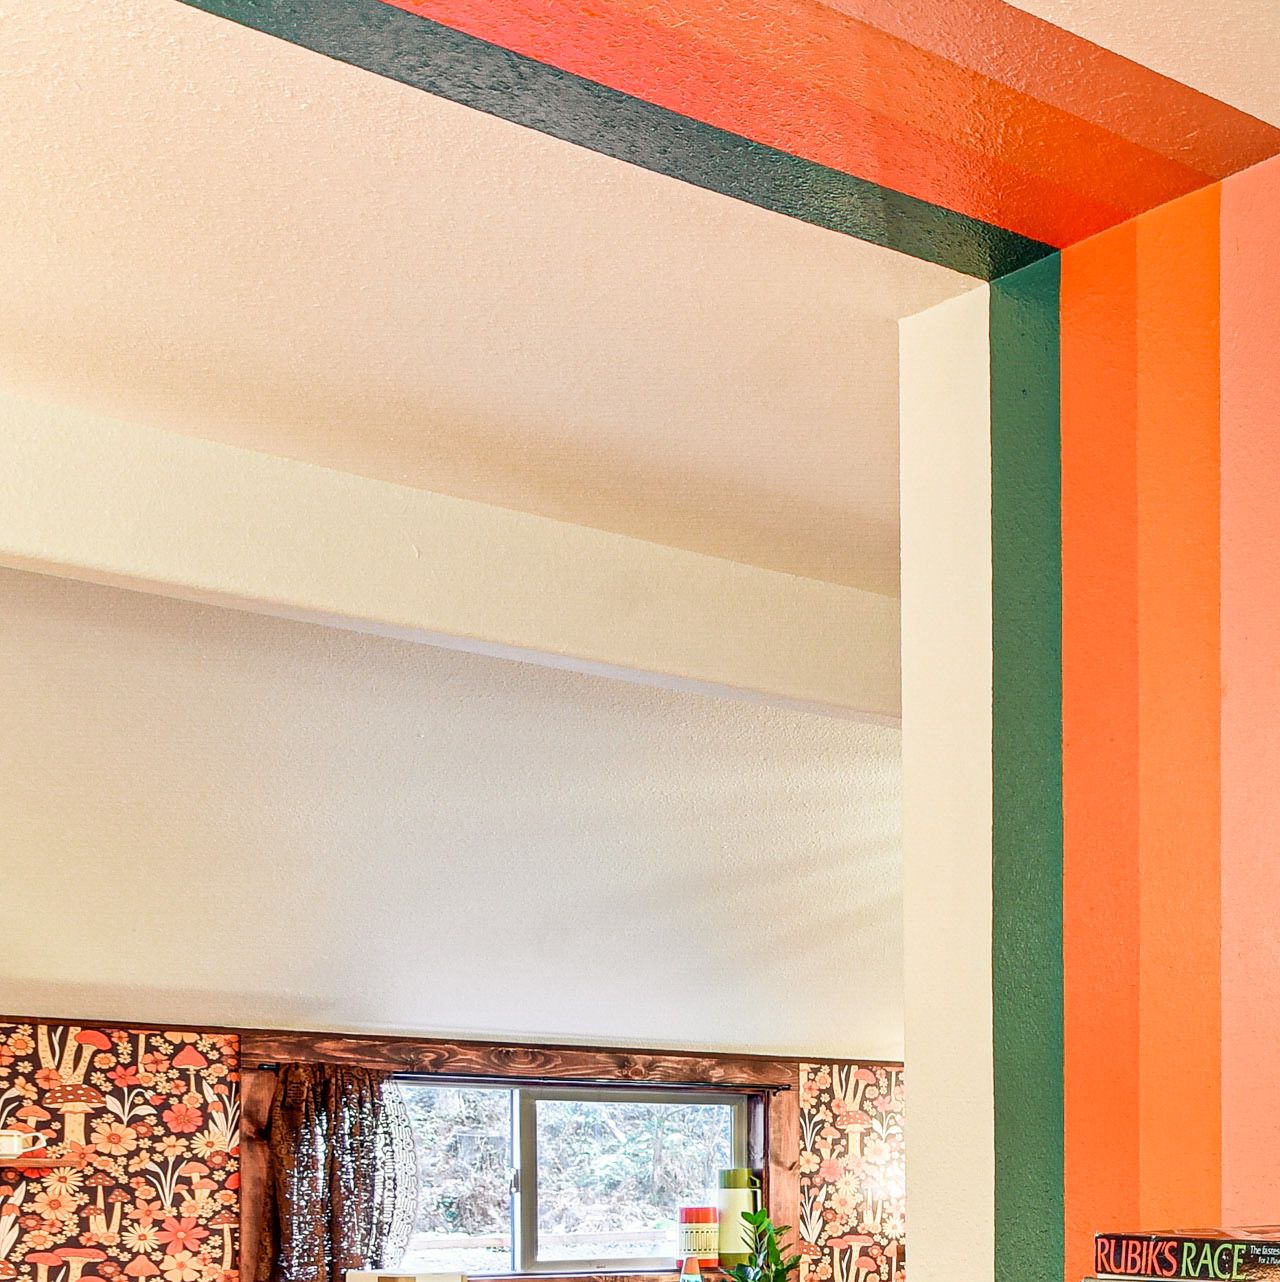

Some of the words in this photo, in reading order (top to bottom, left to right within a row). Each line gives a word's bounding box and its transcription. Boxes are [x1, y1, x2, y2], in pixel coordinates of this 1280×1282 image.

[1097, 1238, 1178, 1277] RUBIK'S
[1180, 1242, 1247, 1281] RACE
[1250, 1246, 1261, 1254] The
